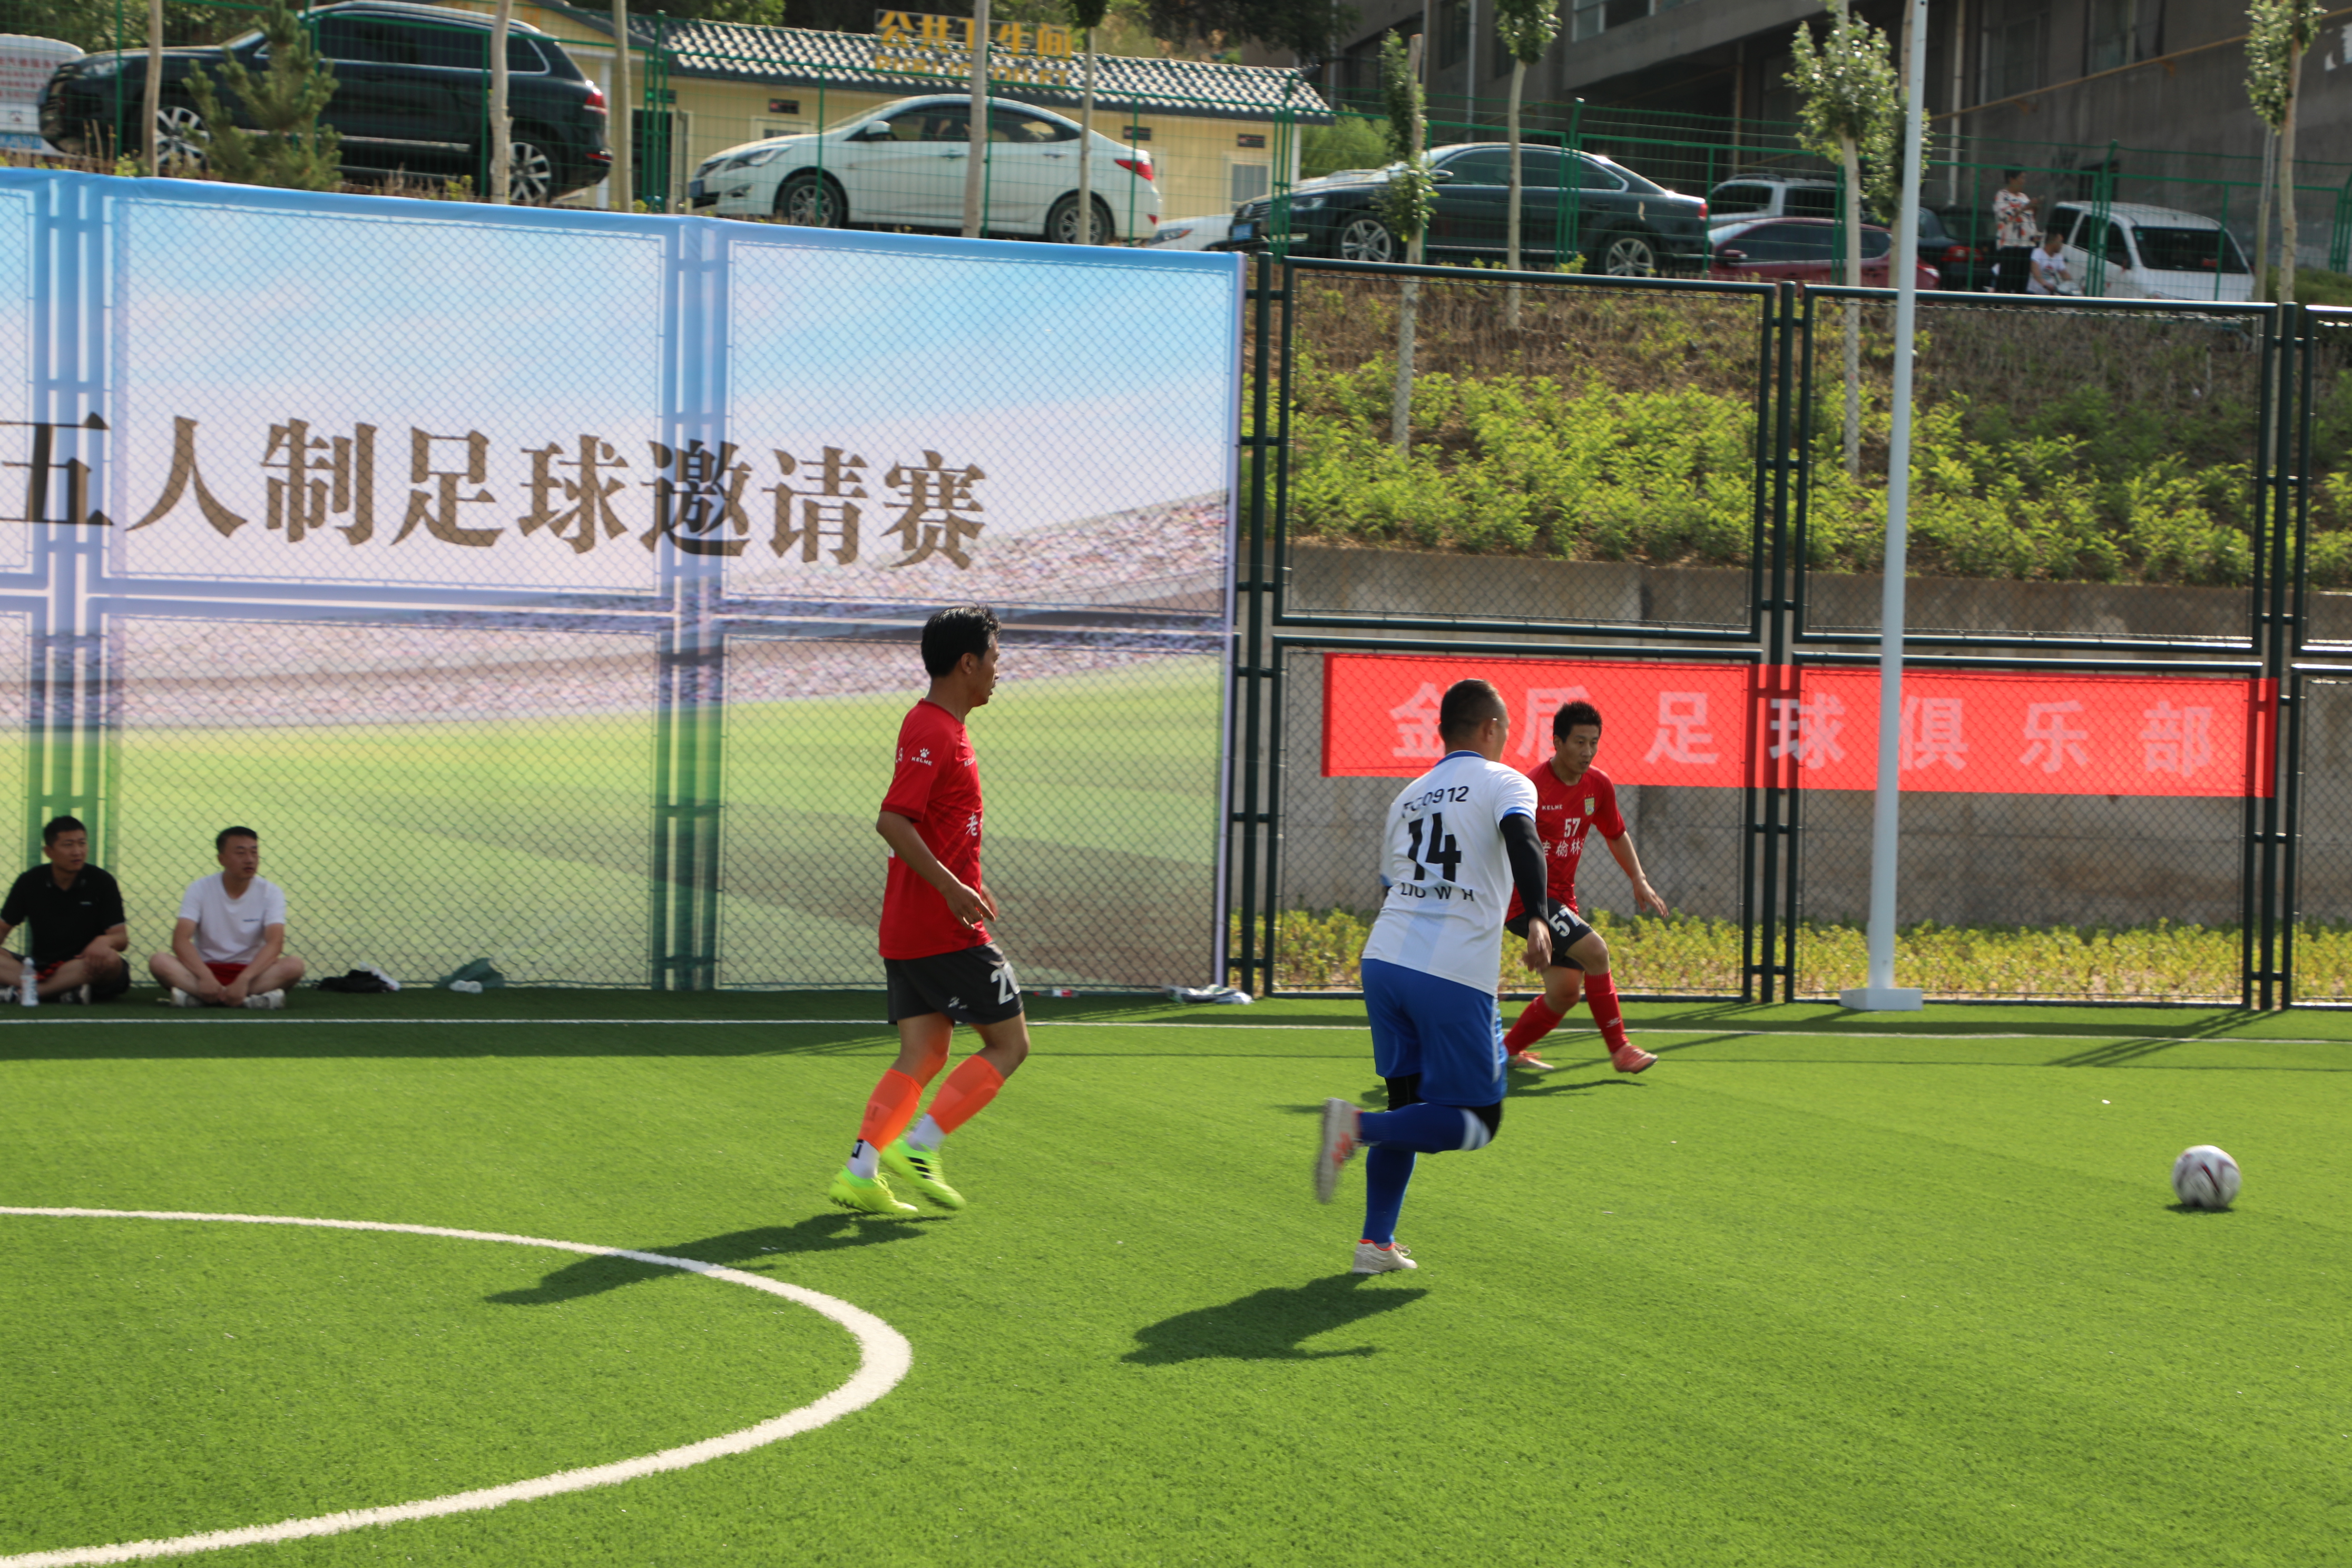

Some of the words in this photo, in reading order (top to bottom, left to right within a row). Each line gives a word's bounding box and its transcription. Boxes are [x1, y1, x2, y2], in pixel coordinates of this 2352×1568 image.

[986, 64, 1068, 86] OILET
[911, 756, 933, 766] KELME
[1564, 817, 1581, 838] 57
[1408, 812, 1462, 882] 14
[1434, 886, 1452, 899] W
[1549, 906, 1582, 937] 57
